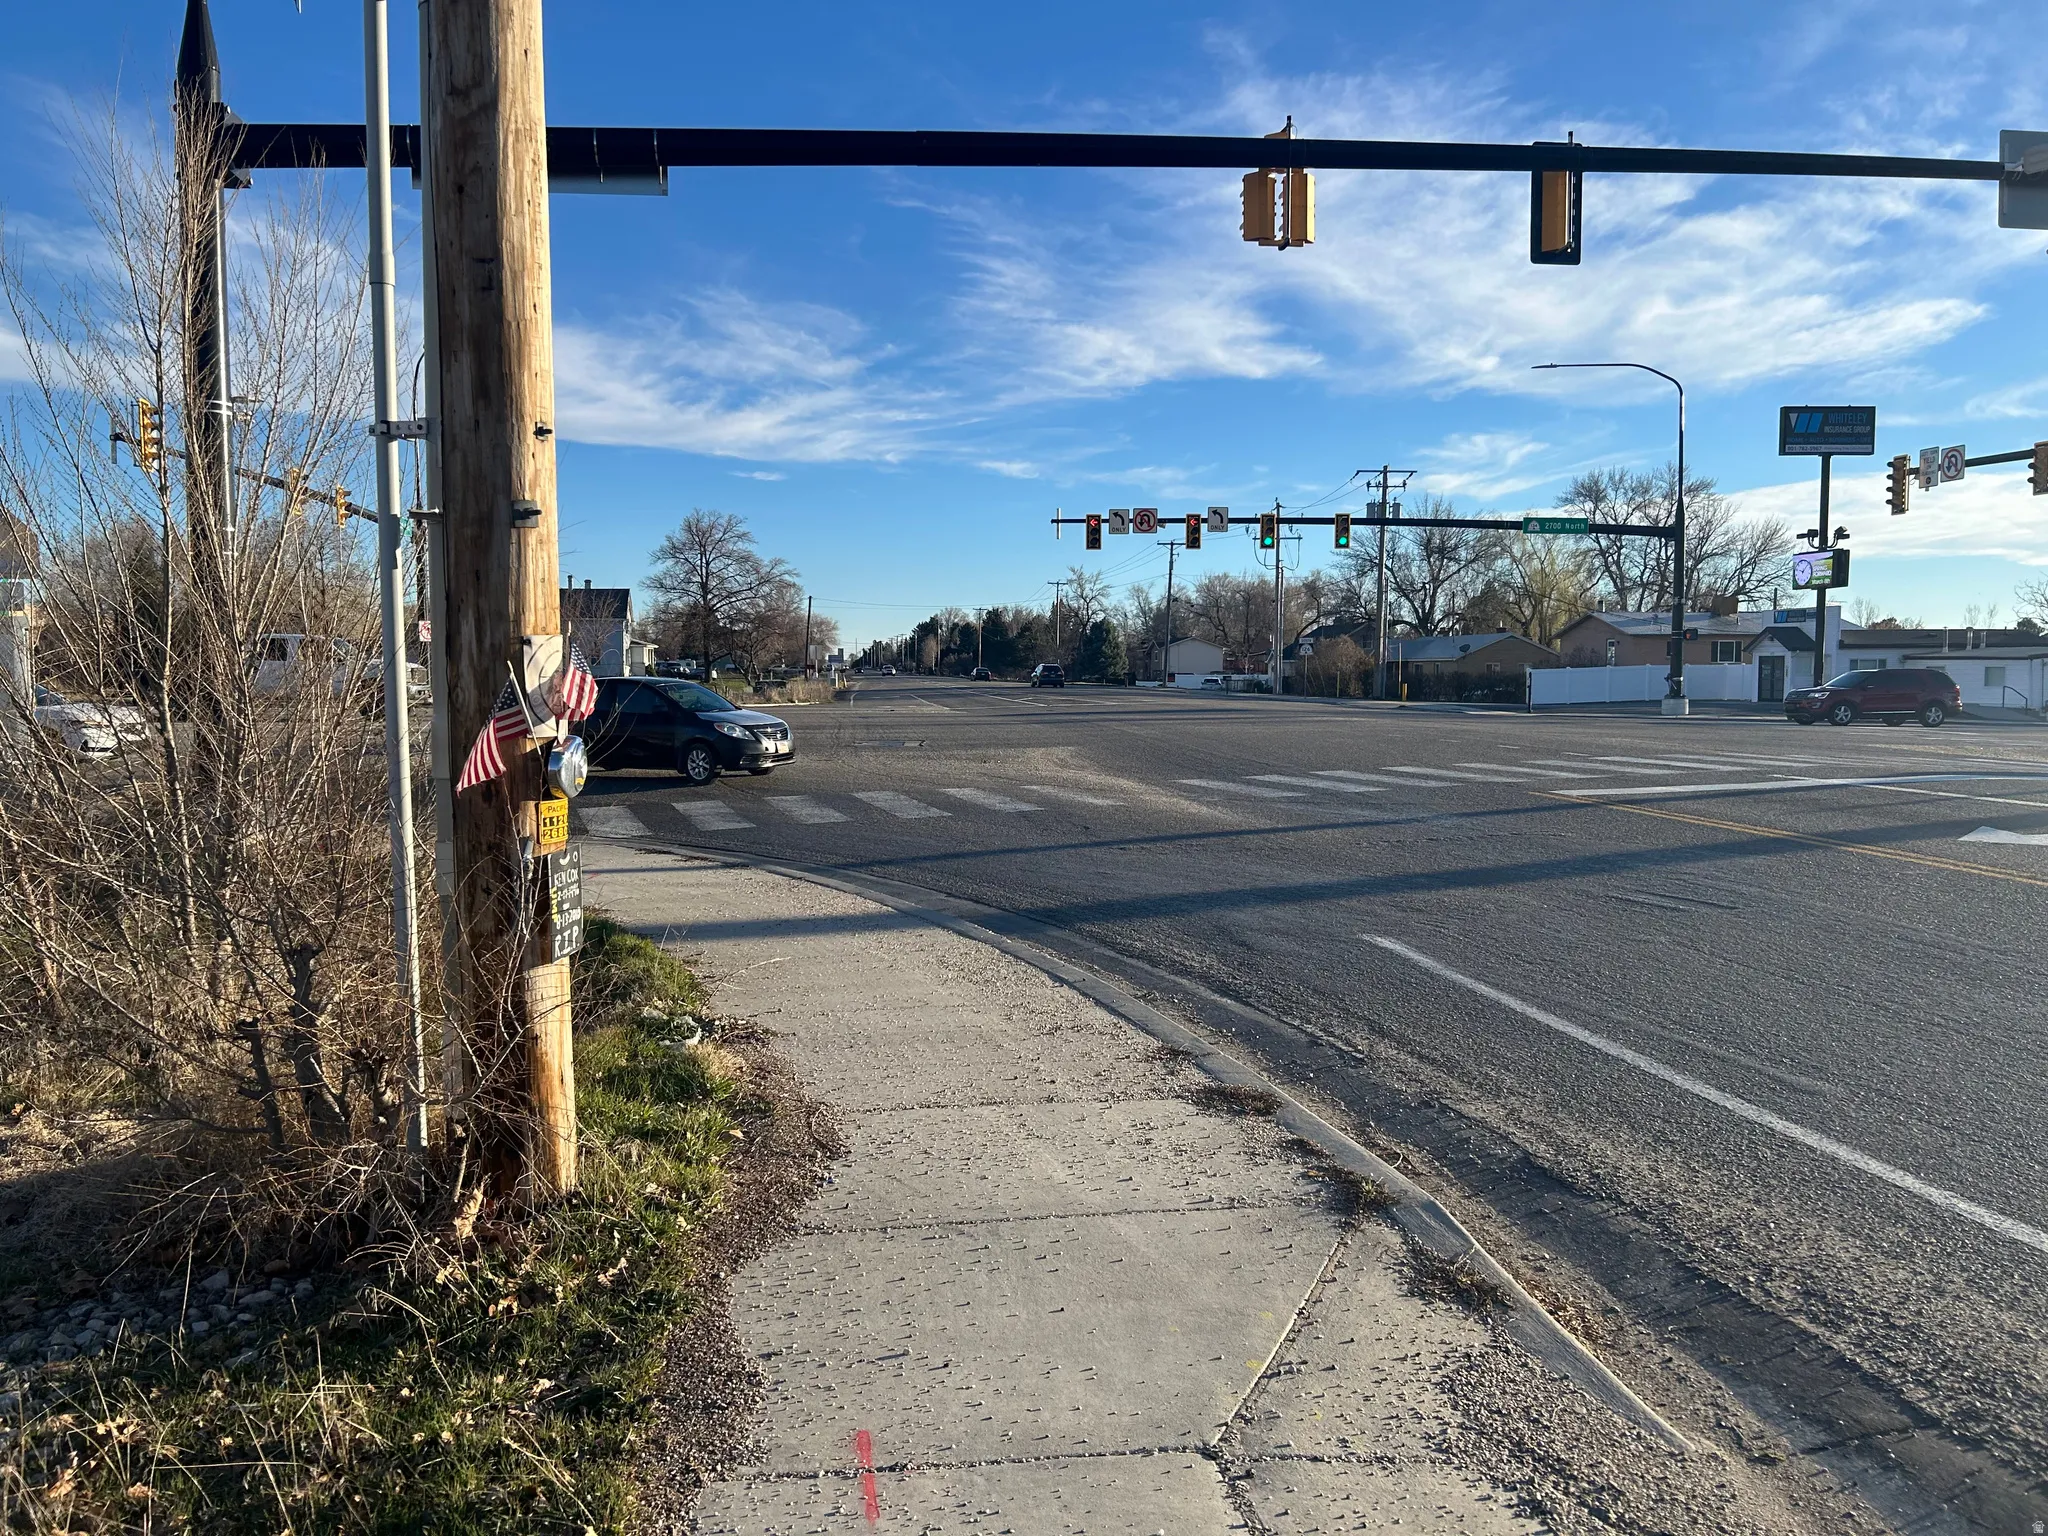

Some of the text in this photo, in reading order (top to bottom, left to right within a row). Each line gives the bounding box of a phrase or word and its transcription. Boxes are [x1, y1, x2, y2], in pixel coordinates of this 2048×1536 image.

[1828, 412, 1867, 424] WHITELEY
[1824, 425, 1871, 433] INSURANCE GROUP
[1544, 522, 1585, 530] 2700 North
[554, 868, 579, 887] KEN COX
